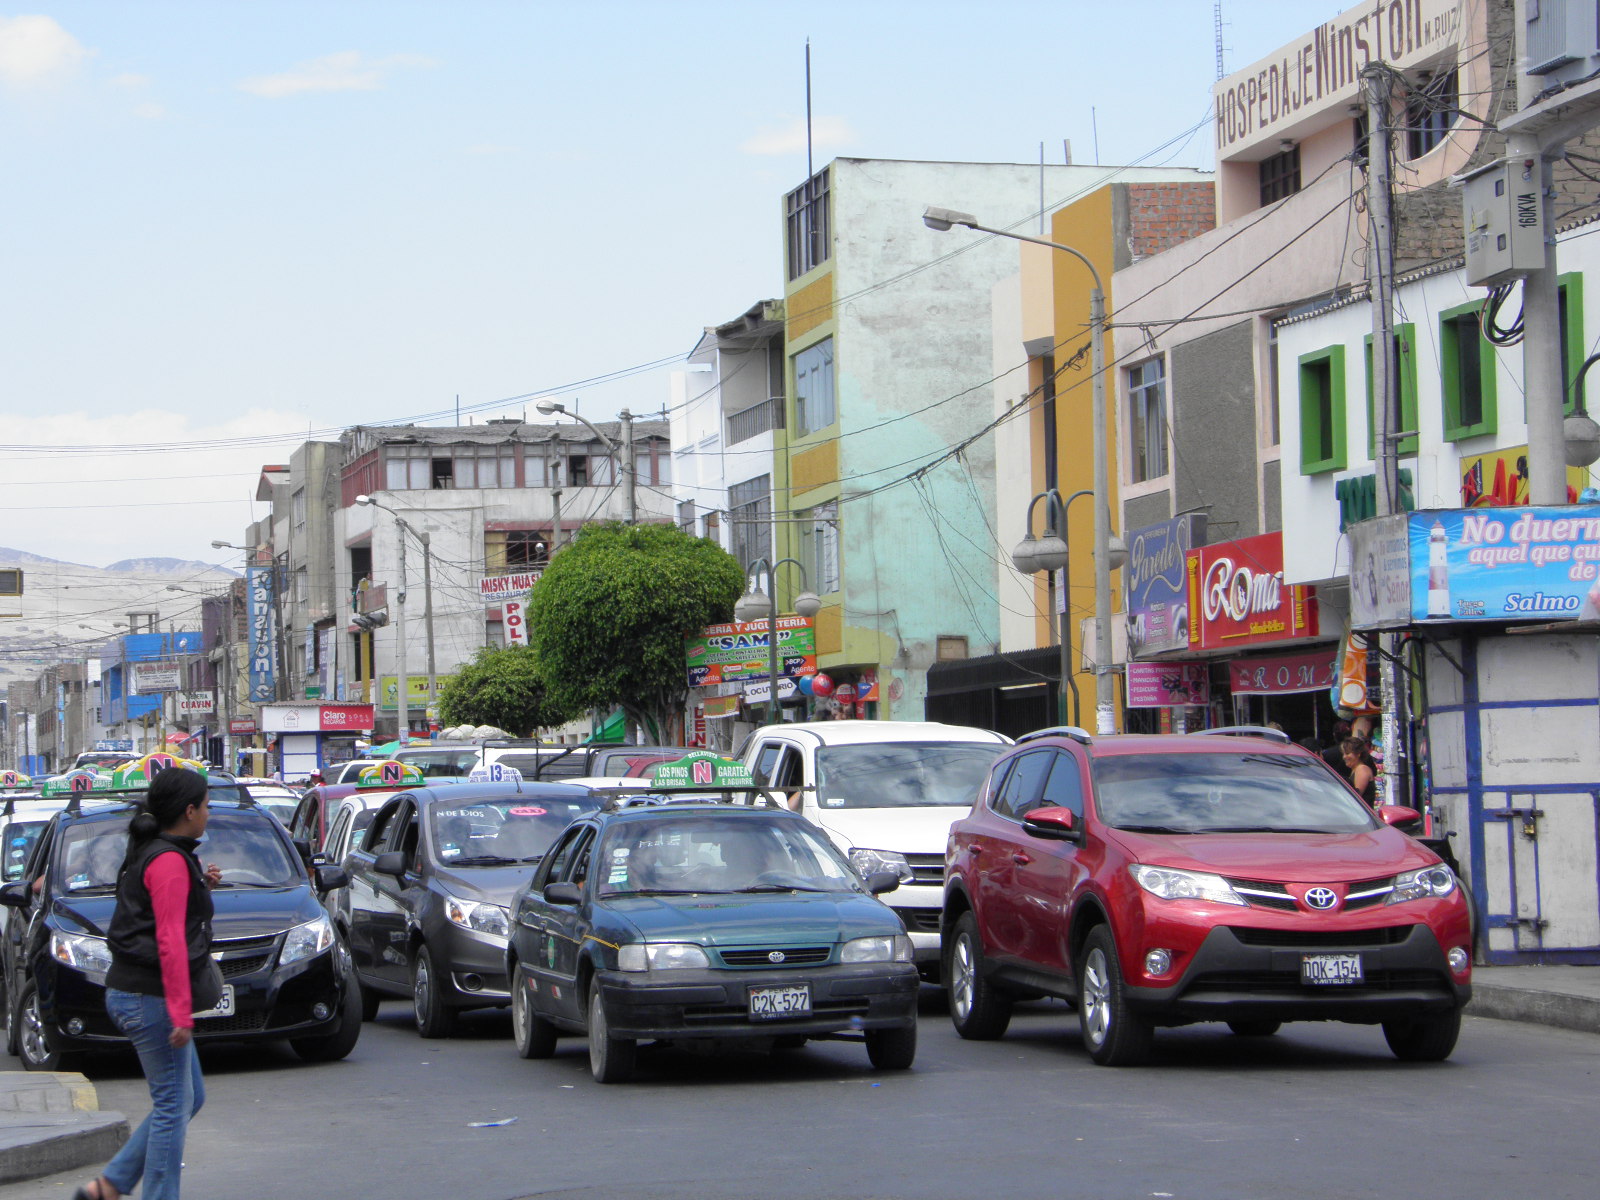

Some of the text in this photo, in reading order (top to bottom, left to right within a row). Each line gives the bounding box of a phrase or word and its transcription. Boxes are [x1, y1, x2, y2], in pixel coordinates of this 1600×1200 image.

[1216, 43, 1314, 150] HOSPEDAJE
[1517, 193, 1537, 228] 160KVA
[1460, 515, 1505, 544] No
[1468, 539, 1528, 568] aquel
[1530, 545, 1571, 568] que
[1568, 561, 1597, 581] de
[481, 577, 510, 593] MISKY
[1386, 575, 1409, 604] Señor
[1504, 591, 1580, 612] Salmo
[744, 618, 807, 631] JUGUTERIA
[790, 666, 815, 676] Agente
[695, 675, 720, 684] Agente
[323, 711, 346, 720] Claro
[687, 751, 718, 760] BELLAVISTA
[150, 758, 173, 781] N
[384, 765, 399, 781] N
[490, 765, 502, 781] 13
[659, 766, 689, 778] LOS PINOS
[718, 766, 748, 777] GARATEA
[5, 774, 15, 784] N
[75, 778, 88, 791] N
[751, 992, 808, 1013] C2K-527
